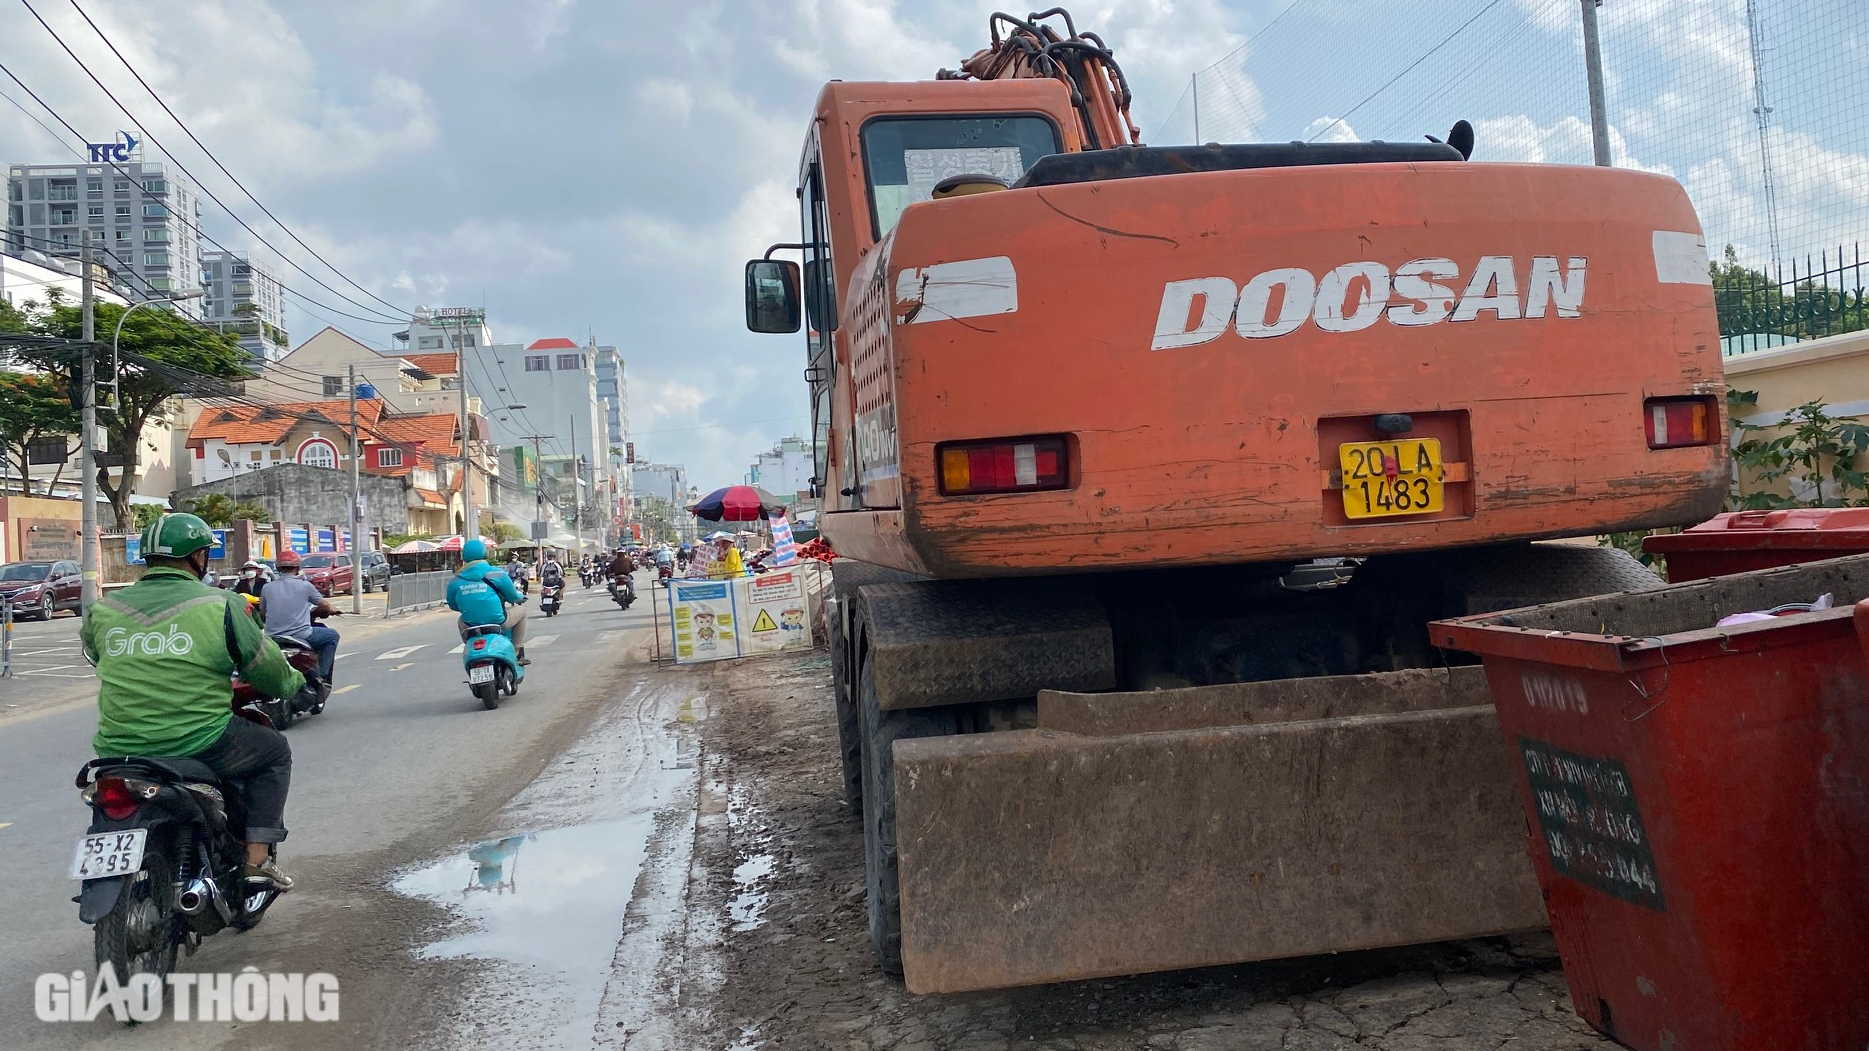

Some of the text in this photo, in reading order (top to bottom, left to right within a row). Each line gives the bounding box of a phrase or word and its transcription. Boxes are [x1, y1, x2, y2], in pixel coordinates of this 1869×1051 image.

[87, 143, 130, 162] TTC
[441, 307, 468, 316] HOTEL
[1151, 255, 1588, 350] DOOSAN
[1348, 442, 1433, 479] 20 LA
[1361, 477, 1430, 513] 1483
[105, 623, 194, 657] Grab
[84, 833, 135, 856] 55-X2
